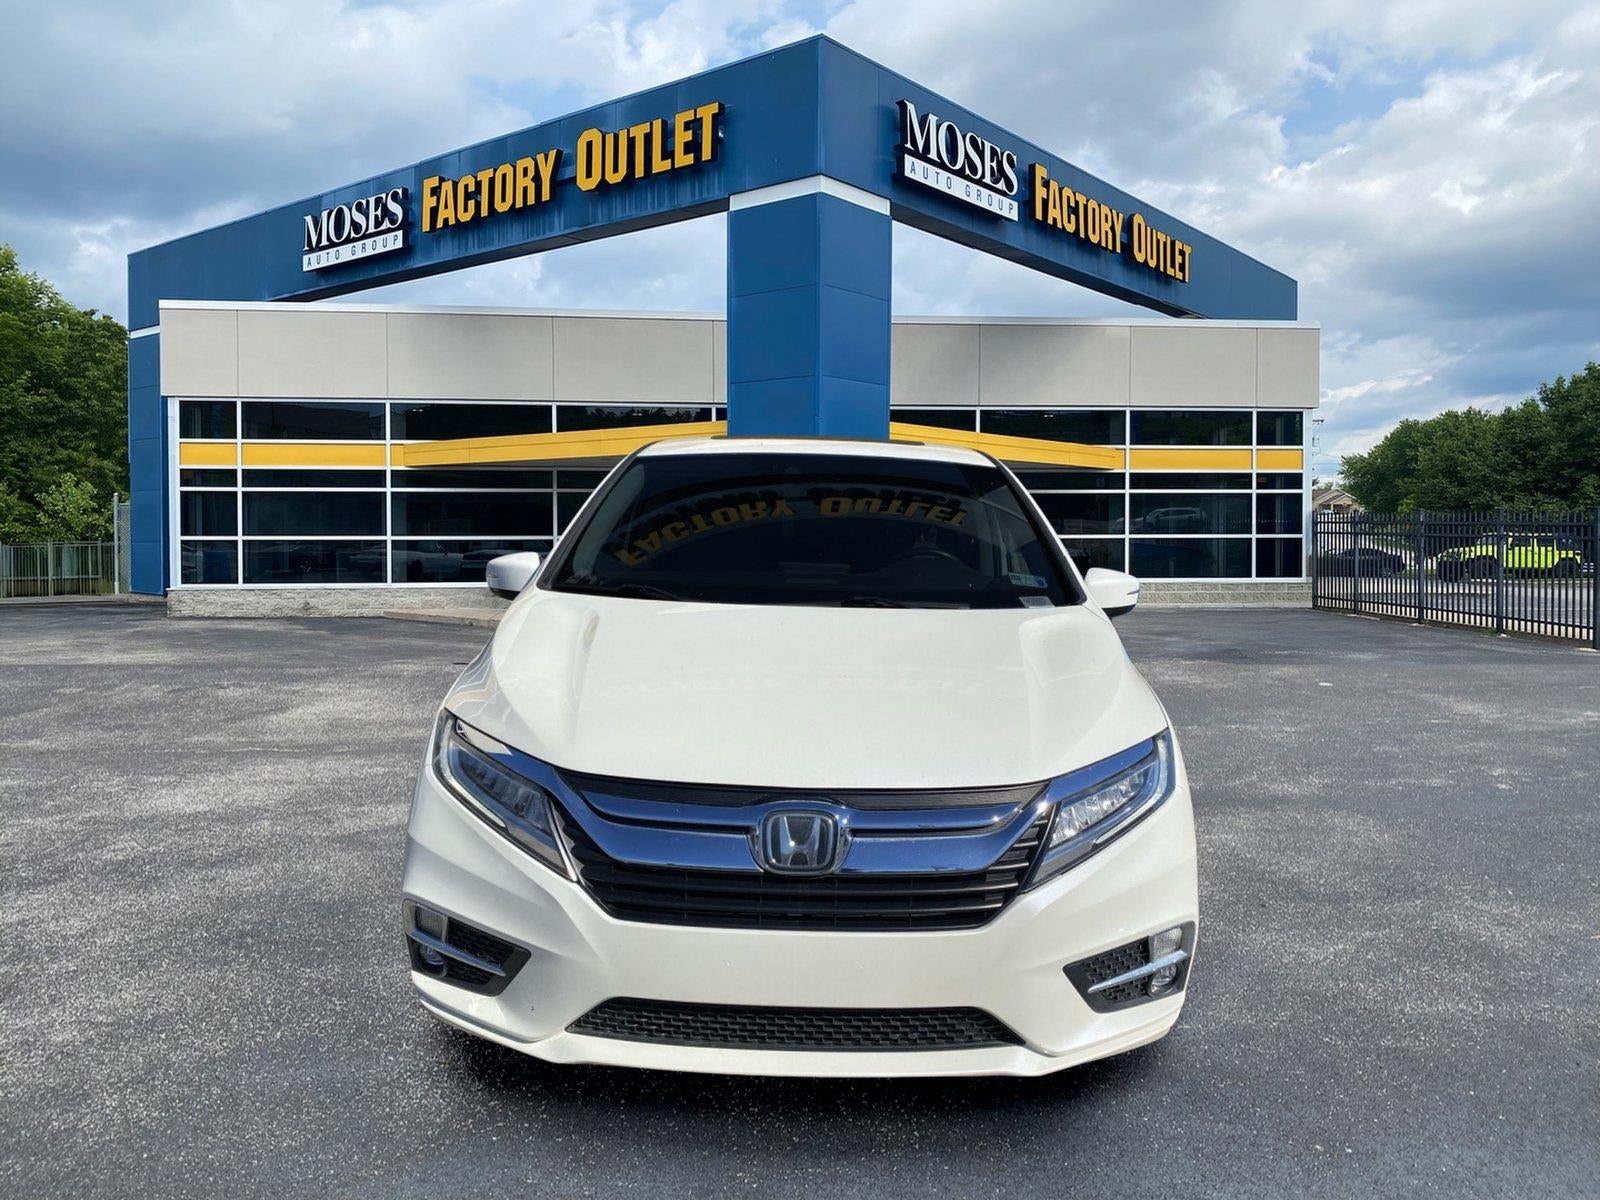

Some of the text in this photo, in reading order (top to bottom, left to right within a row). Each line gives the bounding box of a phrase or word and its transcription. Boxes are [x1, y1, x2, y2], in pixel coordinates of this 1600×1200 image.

[421, 101, 720, 233] FACTORY OUTLET
[903, 99, 1019, 196] MOSES
[909, 161, 1015, 215] AUTO GROUP
[302, 187, 404, 252] MOSES
[306, 233, 400, 268] AUTO GROUP
[1033, 163, 1192, 283] FACTORY OUTLET
